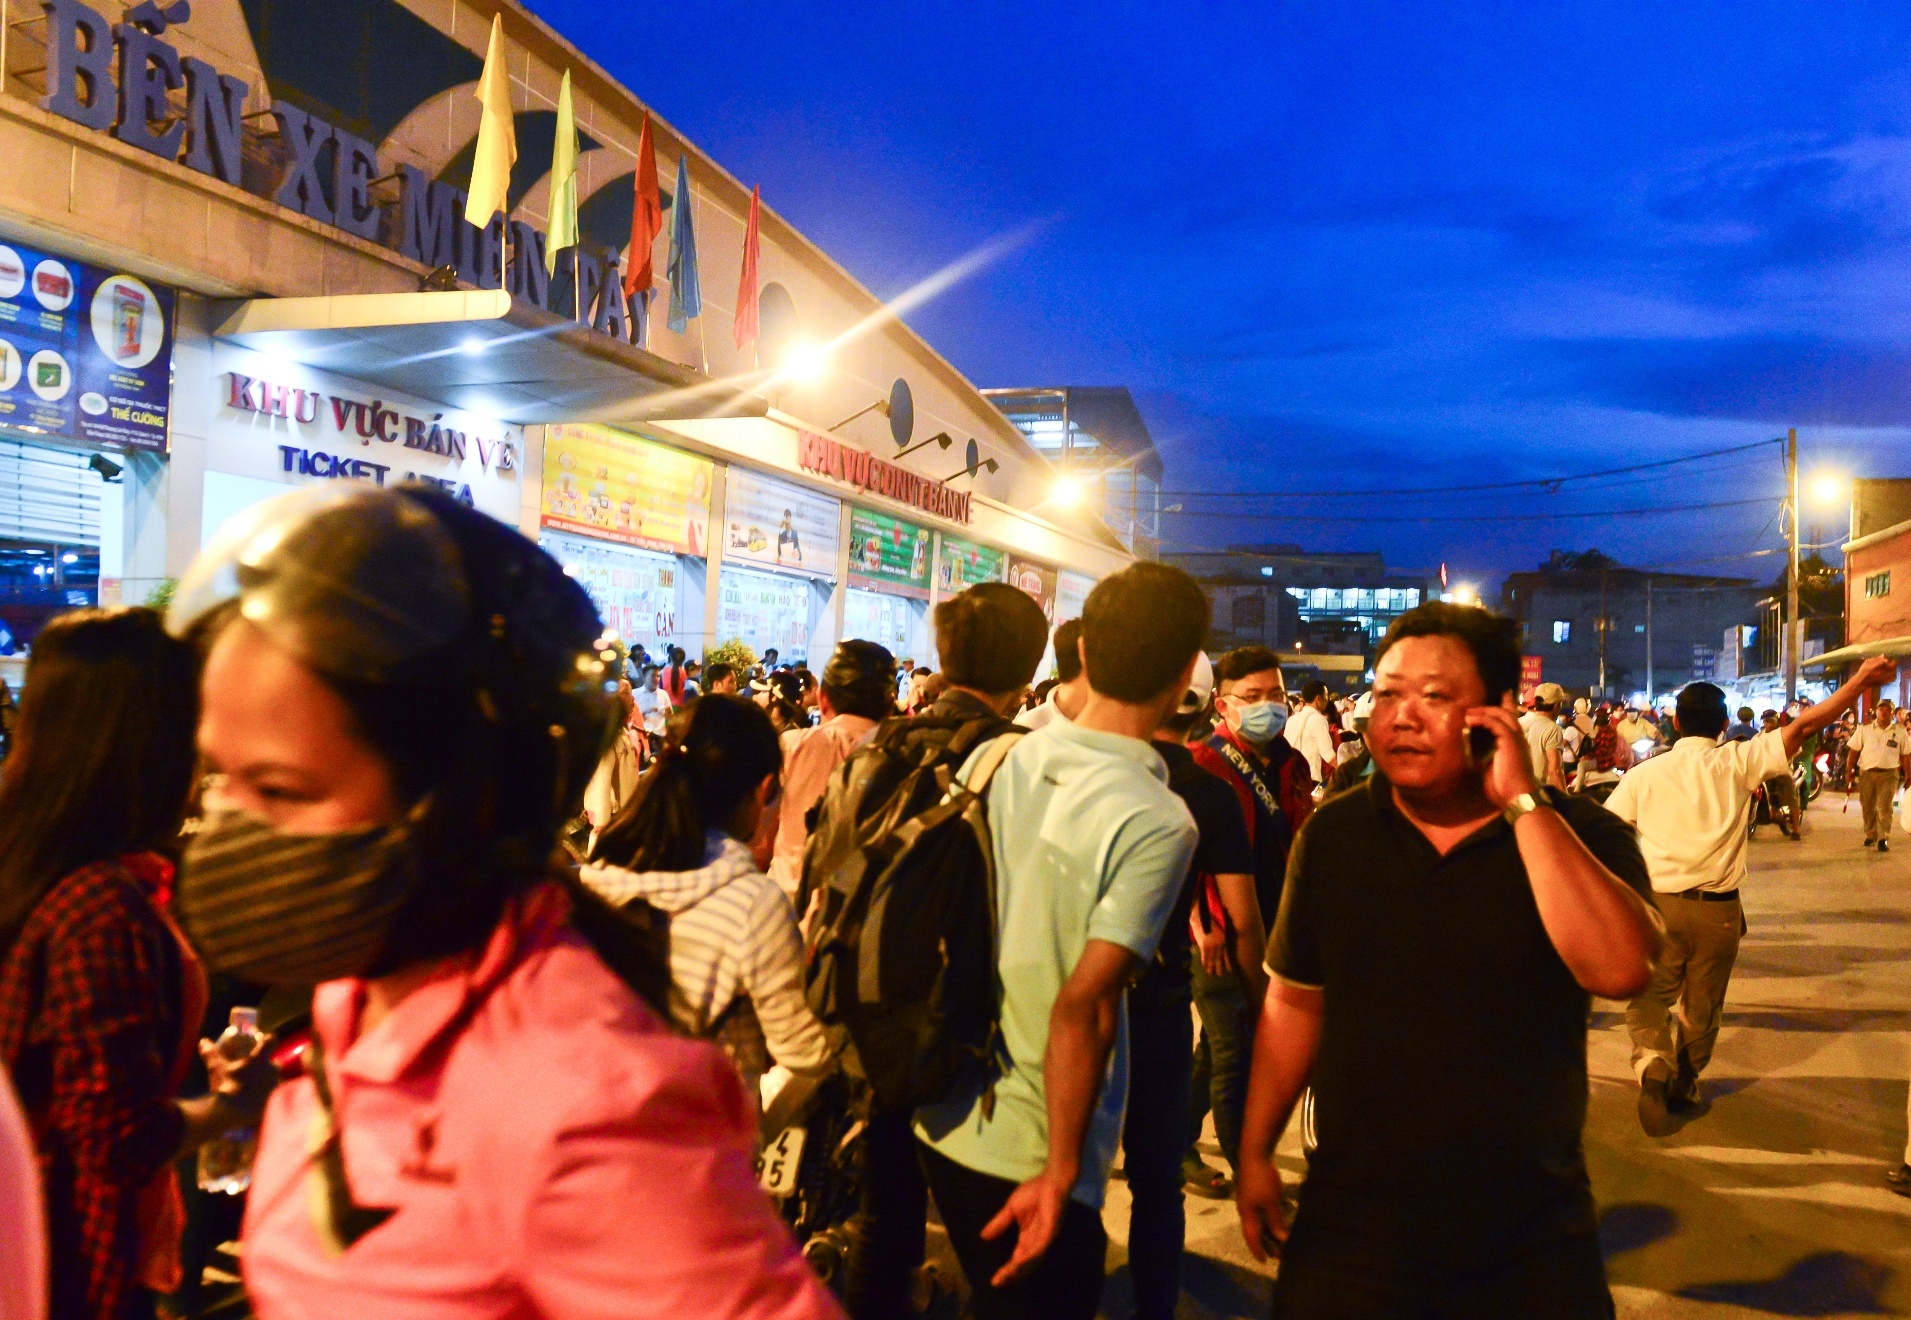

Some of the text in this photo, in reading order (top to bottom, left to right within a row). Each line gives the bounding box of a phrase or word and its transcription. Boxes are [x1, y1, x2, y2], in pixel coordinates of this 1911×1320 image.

[38, 0, 249, 187] BẾN
[271, 100, 381, 240] XE
[227, 371, 320, 424] KHU
[328, 395, 399, 446] VỰC
[403, 413, 468, 461] BÁN
[798, 429, 842, 475] KHU
[278, 444, 475, 508] TICKET EA
[1221, 743, 1280, 816] NEW YORK
